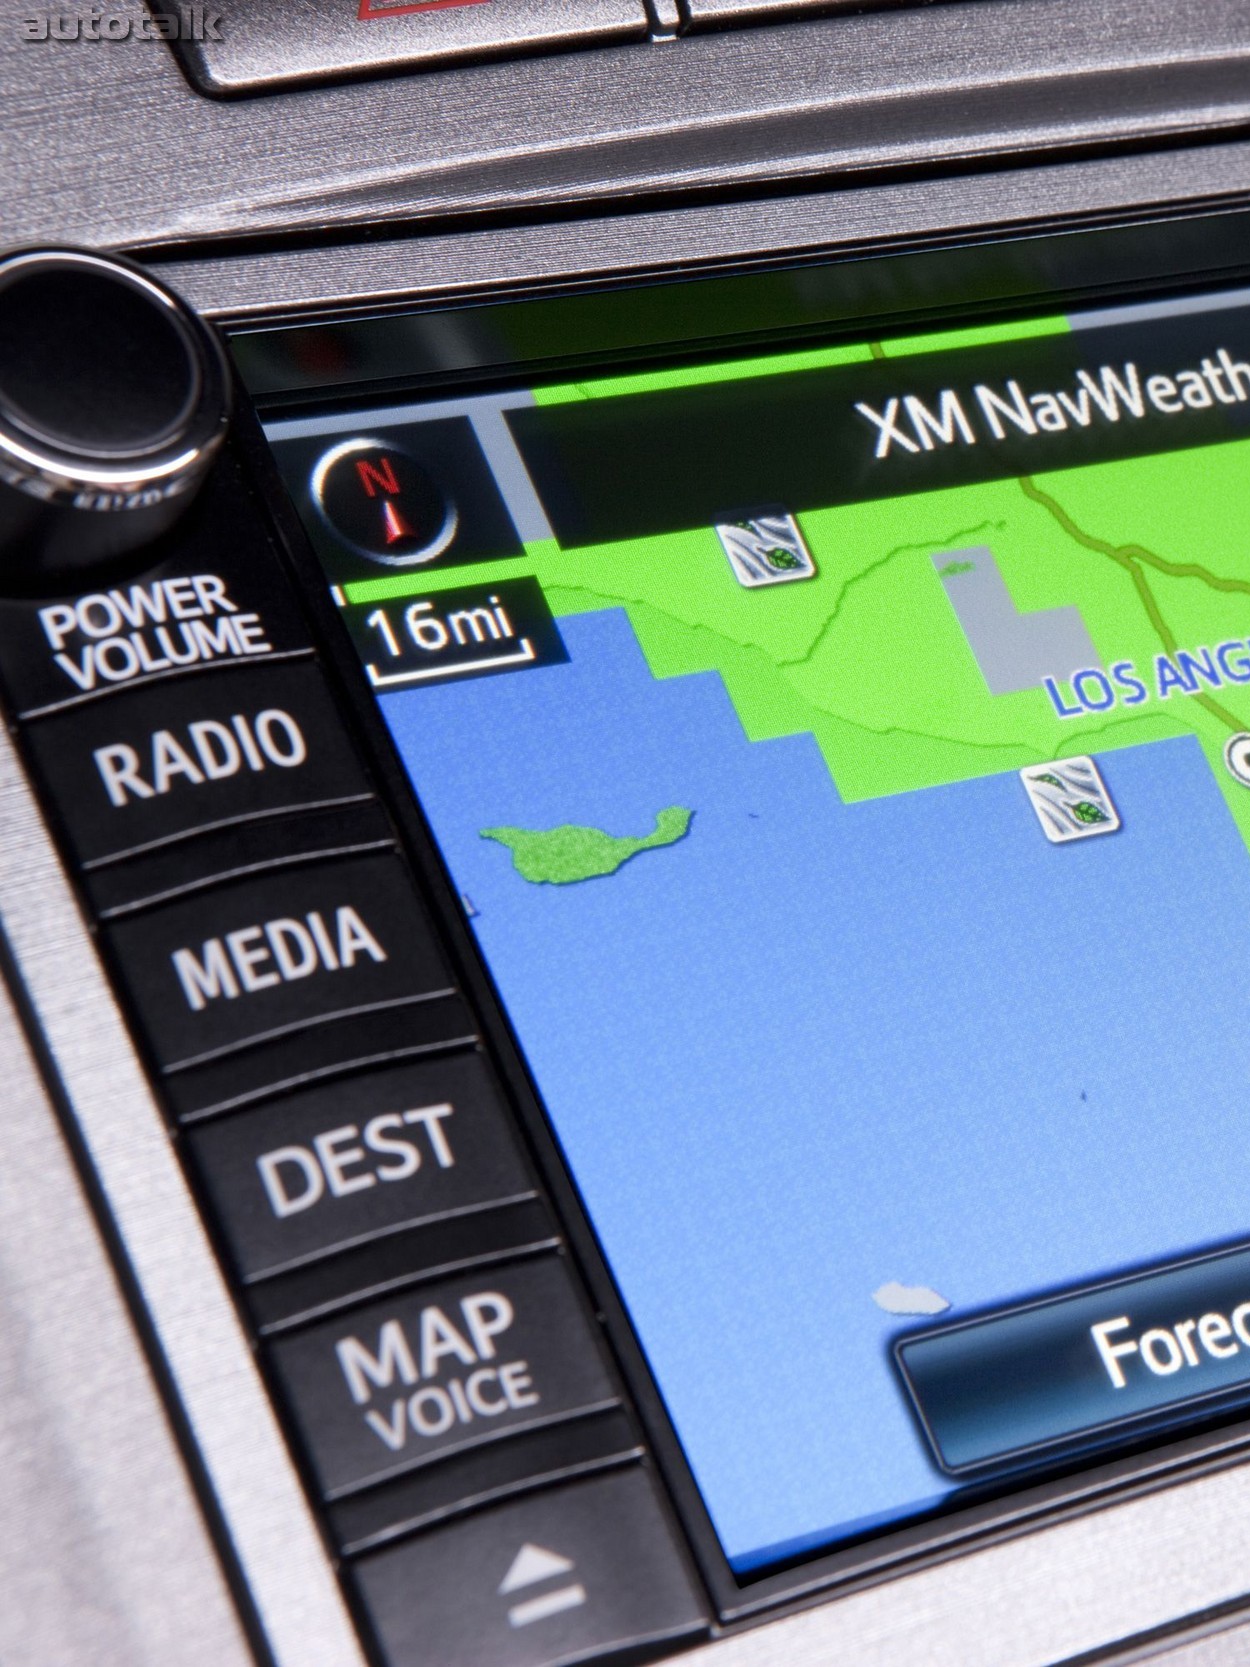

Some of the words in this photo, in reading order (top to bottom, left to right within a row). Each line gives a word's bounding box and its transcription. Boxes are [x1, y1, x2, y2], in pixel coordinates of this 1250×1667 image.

[855, 388, 976, 459] XM
[354, 456, 400, 498] N
[38, 575, 236, 651] POWER
[54, 612, 273, 691] VOLUME
[1042, 662, 1148, 719] LOS
[93, 709, 307, 807] RADIO
[171, 906, 387, 1010] MEDIA
[255, 1103, 454, 1219] DEST
[334, 1291, 515, 1405] MAP
[365, 1361, 541, 1450] VOICE
